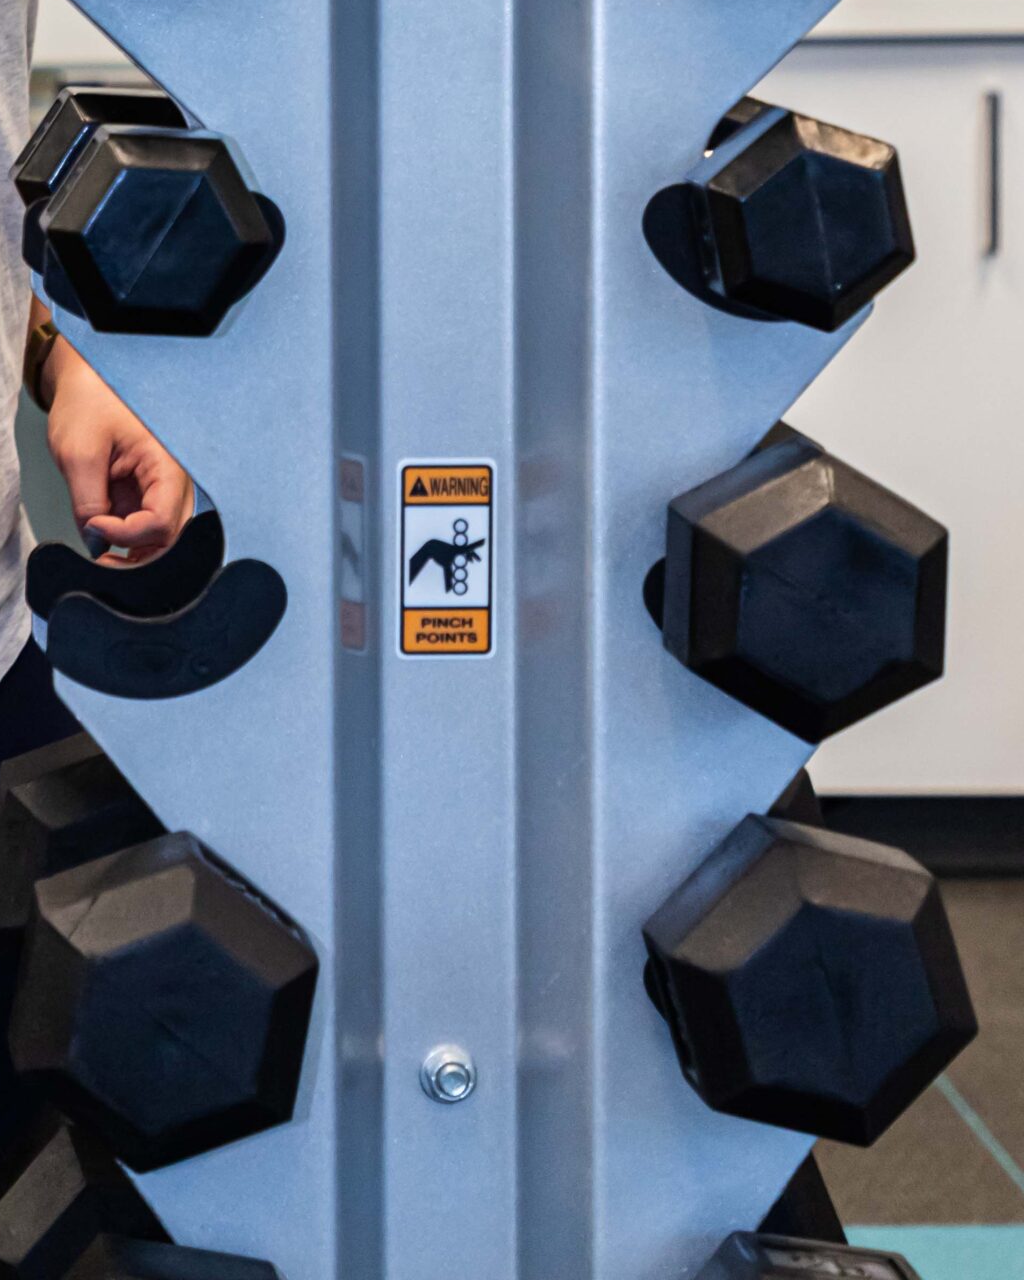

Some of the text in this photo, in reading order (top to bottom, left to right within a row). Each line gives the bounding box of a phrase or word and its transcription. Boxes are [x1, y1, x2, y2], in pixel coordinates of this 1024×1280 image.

[429, 477, 489, 497] WARNING
[421, 617, 474, 629] PINCH
[415, 632, 478, 644] POINTS
